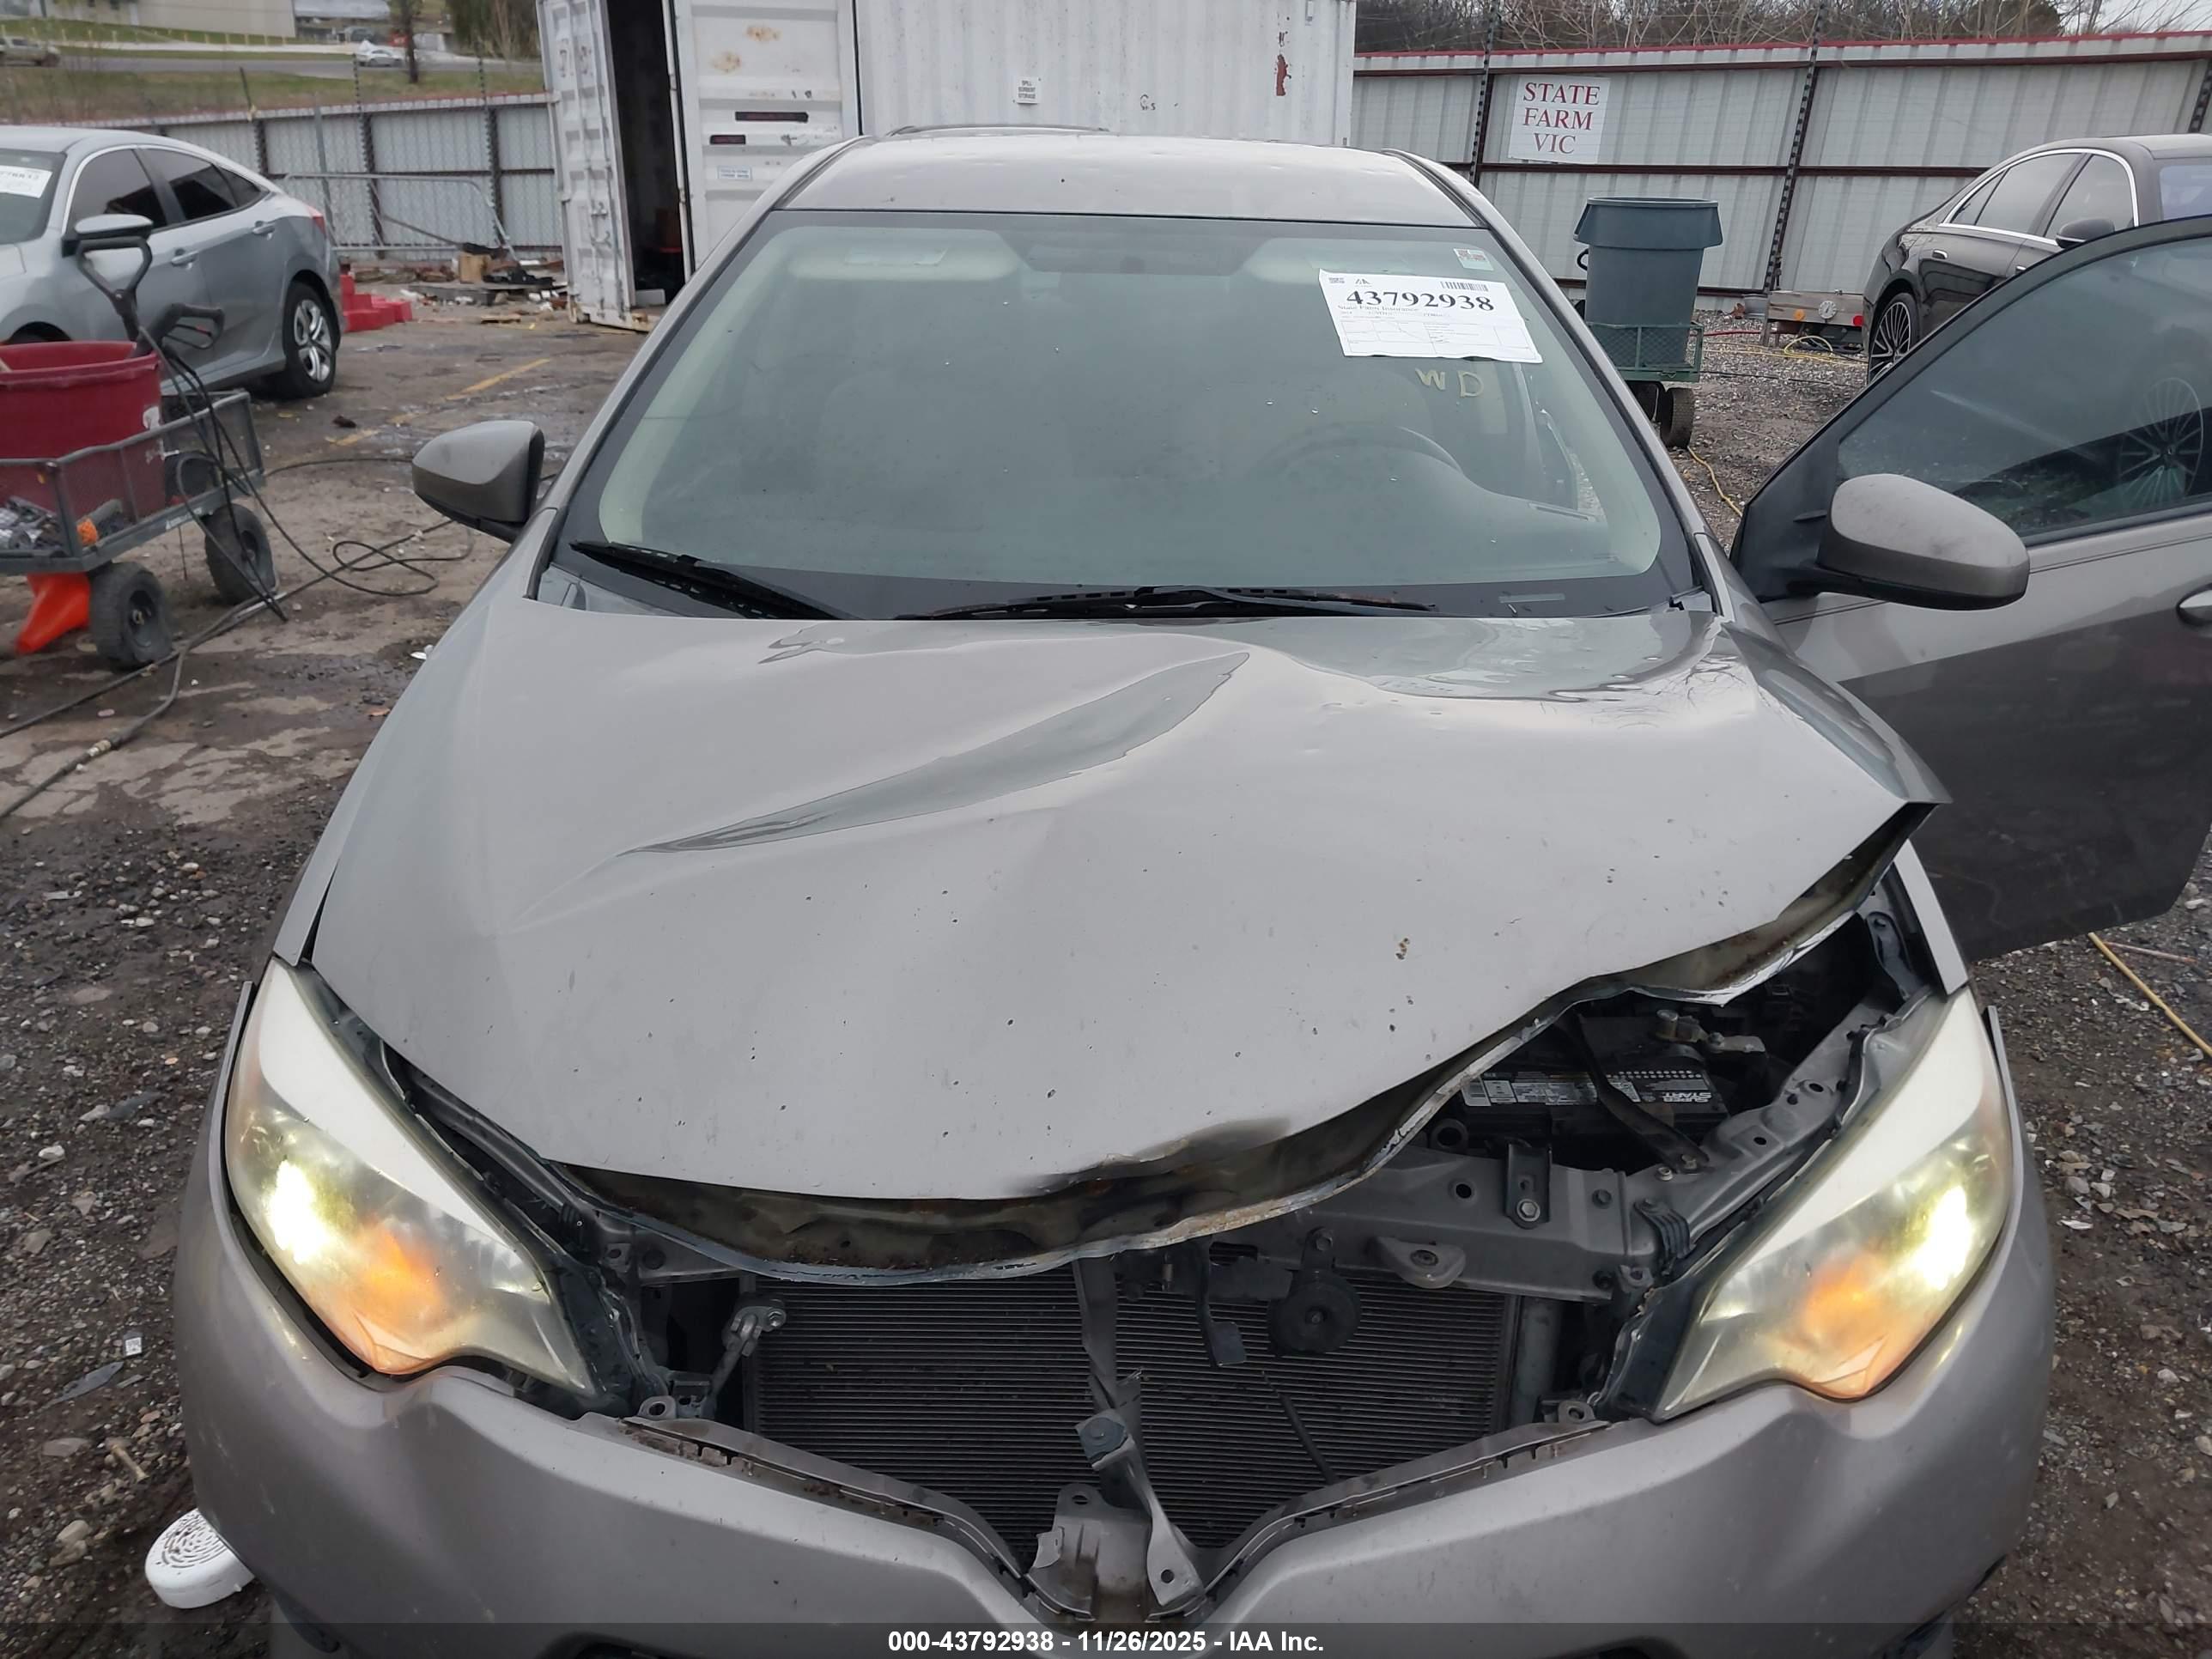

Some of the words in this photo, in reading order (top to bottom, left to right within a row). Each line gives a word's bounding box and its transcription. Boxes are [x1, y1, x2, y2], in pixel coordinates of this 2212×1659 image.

[1523, 82, 1601, 106] STATE
[1522, 107, 1594, 131] FARM
[1534, 132, 1577, 155] VIC
[1346, 289, 1495, 312] 43792938
[1456, 369, 1485, 398] D
